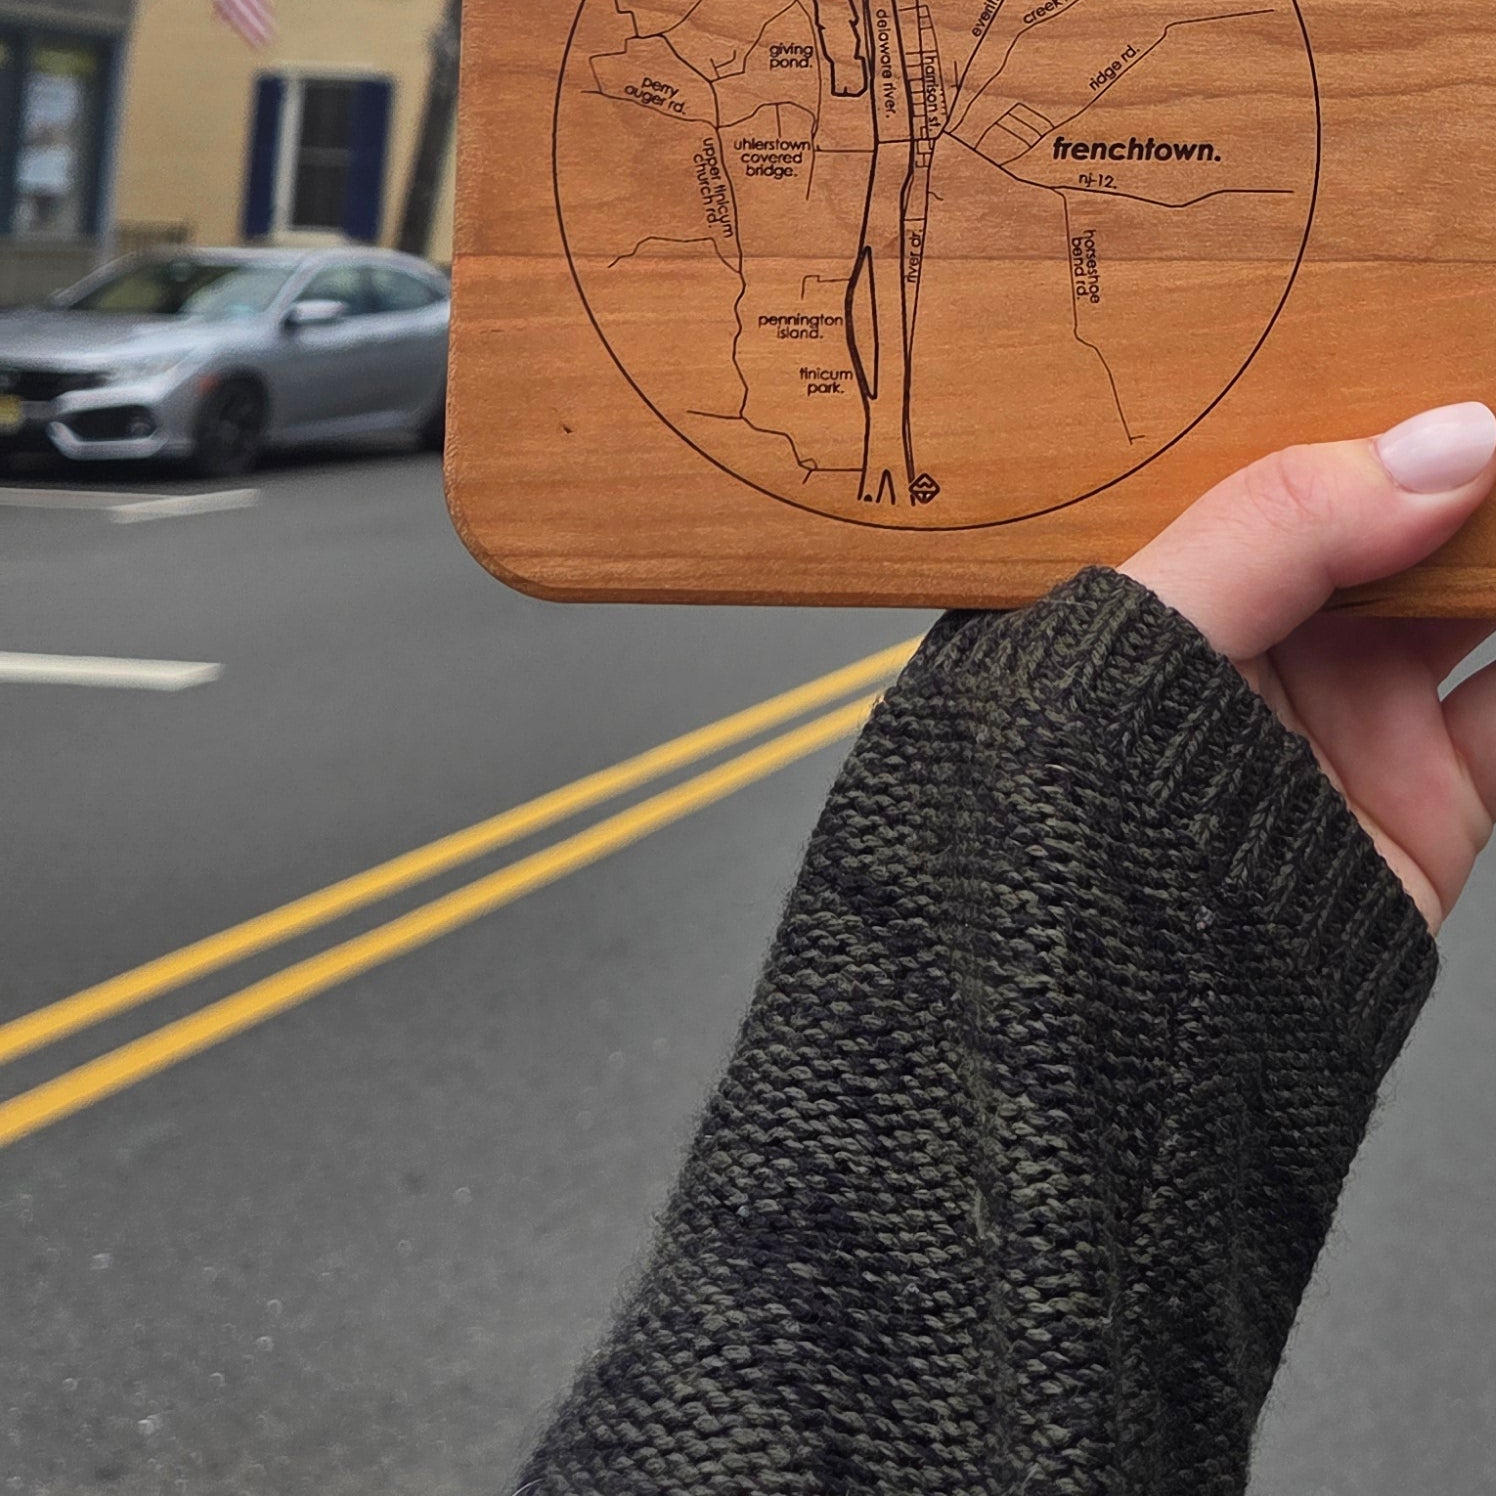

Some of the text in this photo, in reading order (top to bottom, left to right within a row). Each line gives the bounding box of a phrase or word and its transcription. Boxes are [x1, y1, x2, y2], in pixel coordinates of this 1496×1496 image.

[769, 42, 813, 58] giving
[770, 57, 812, 71] pond.
[875, 9, 897, 118] delaware river.
[1089, 44, 1141, 91] ridge rd.
[641, 77, 680, 98] perry
[923, 56, 941, 132] harrison st.
[624, 85, 687, 115] auger rd.
[734, 138, 810, 150] uhlerstown
[1053, 136, 1221, 162] frenchtown.
[741, 151, 802, 164] covered
[746, 164, 798, 180] bridge.
[693, 154, 721, 228] church rd.
[702, 138, 733, 238] upper tinicum
[905, 229, 923, 283] river dr.
[1083, 229, 1100, 304] horseshoe
[1071, 236, 1089, 300] bend rd.
[758, 313, 843, 329] pennington
[777, 326, 824, 339] island.
[799, 367, 853, 380] tinicum
[807, 381, 844, 396] park.
